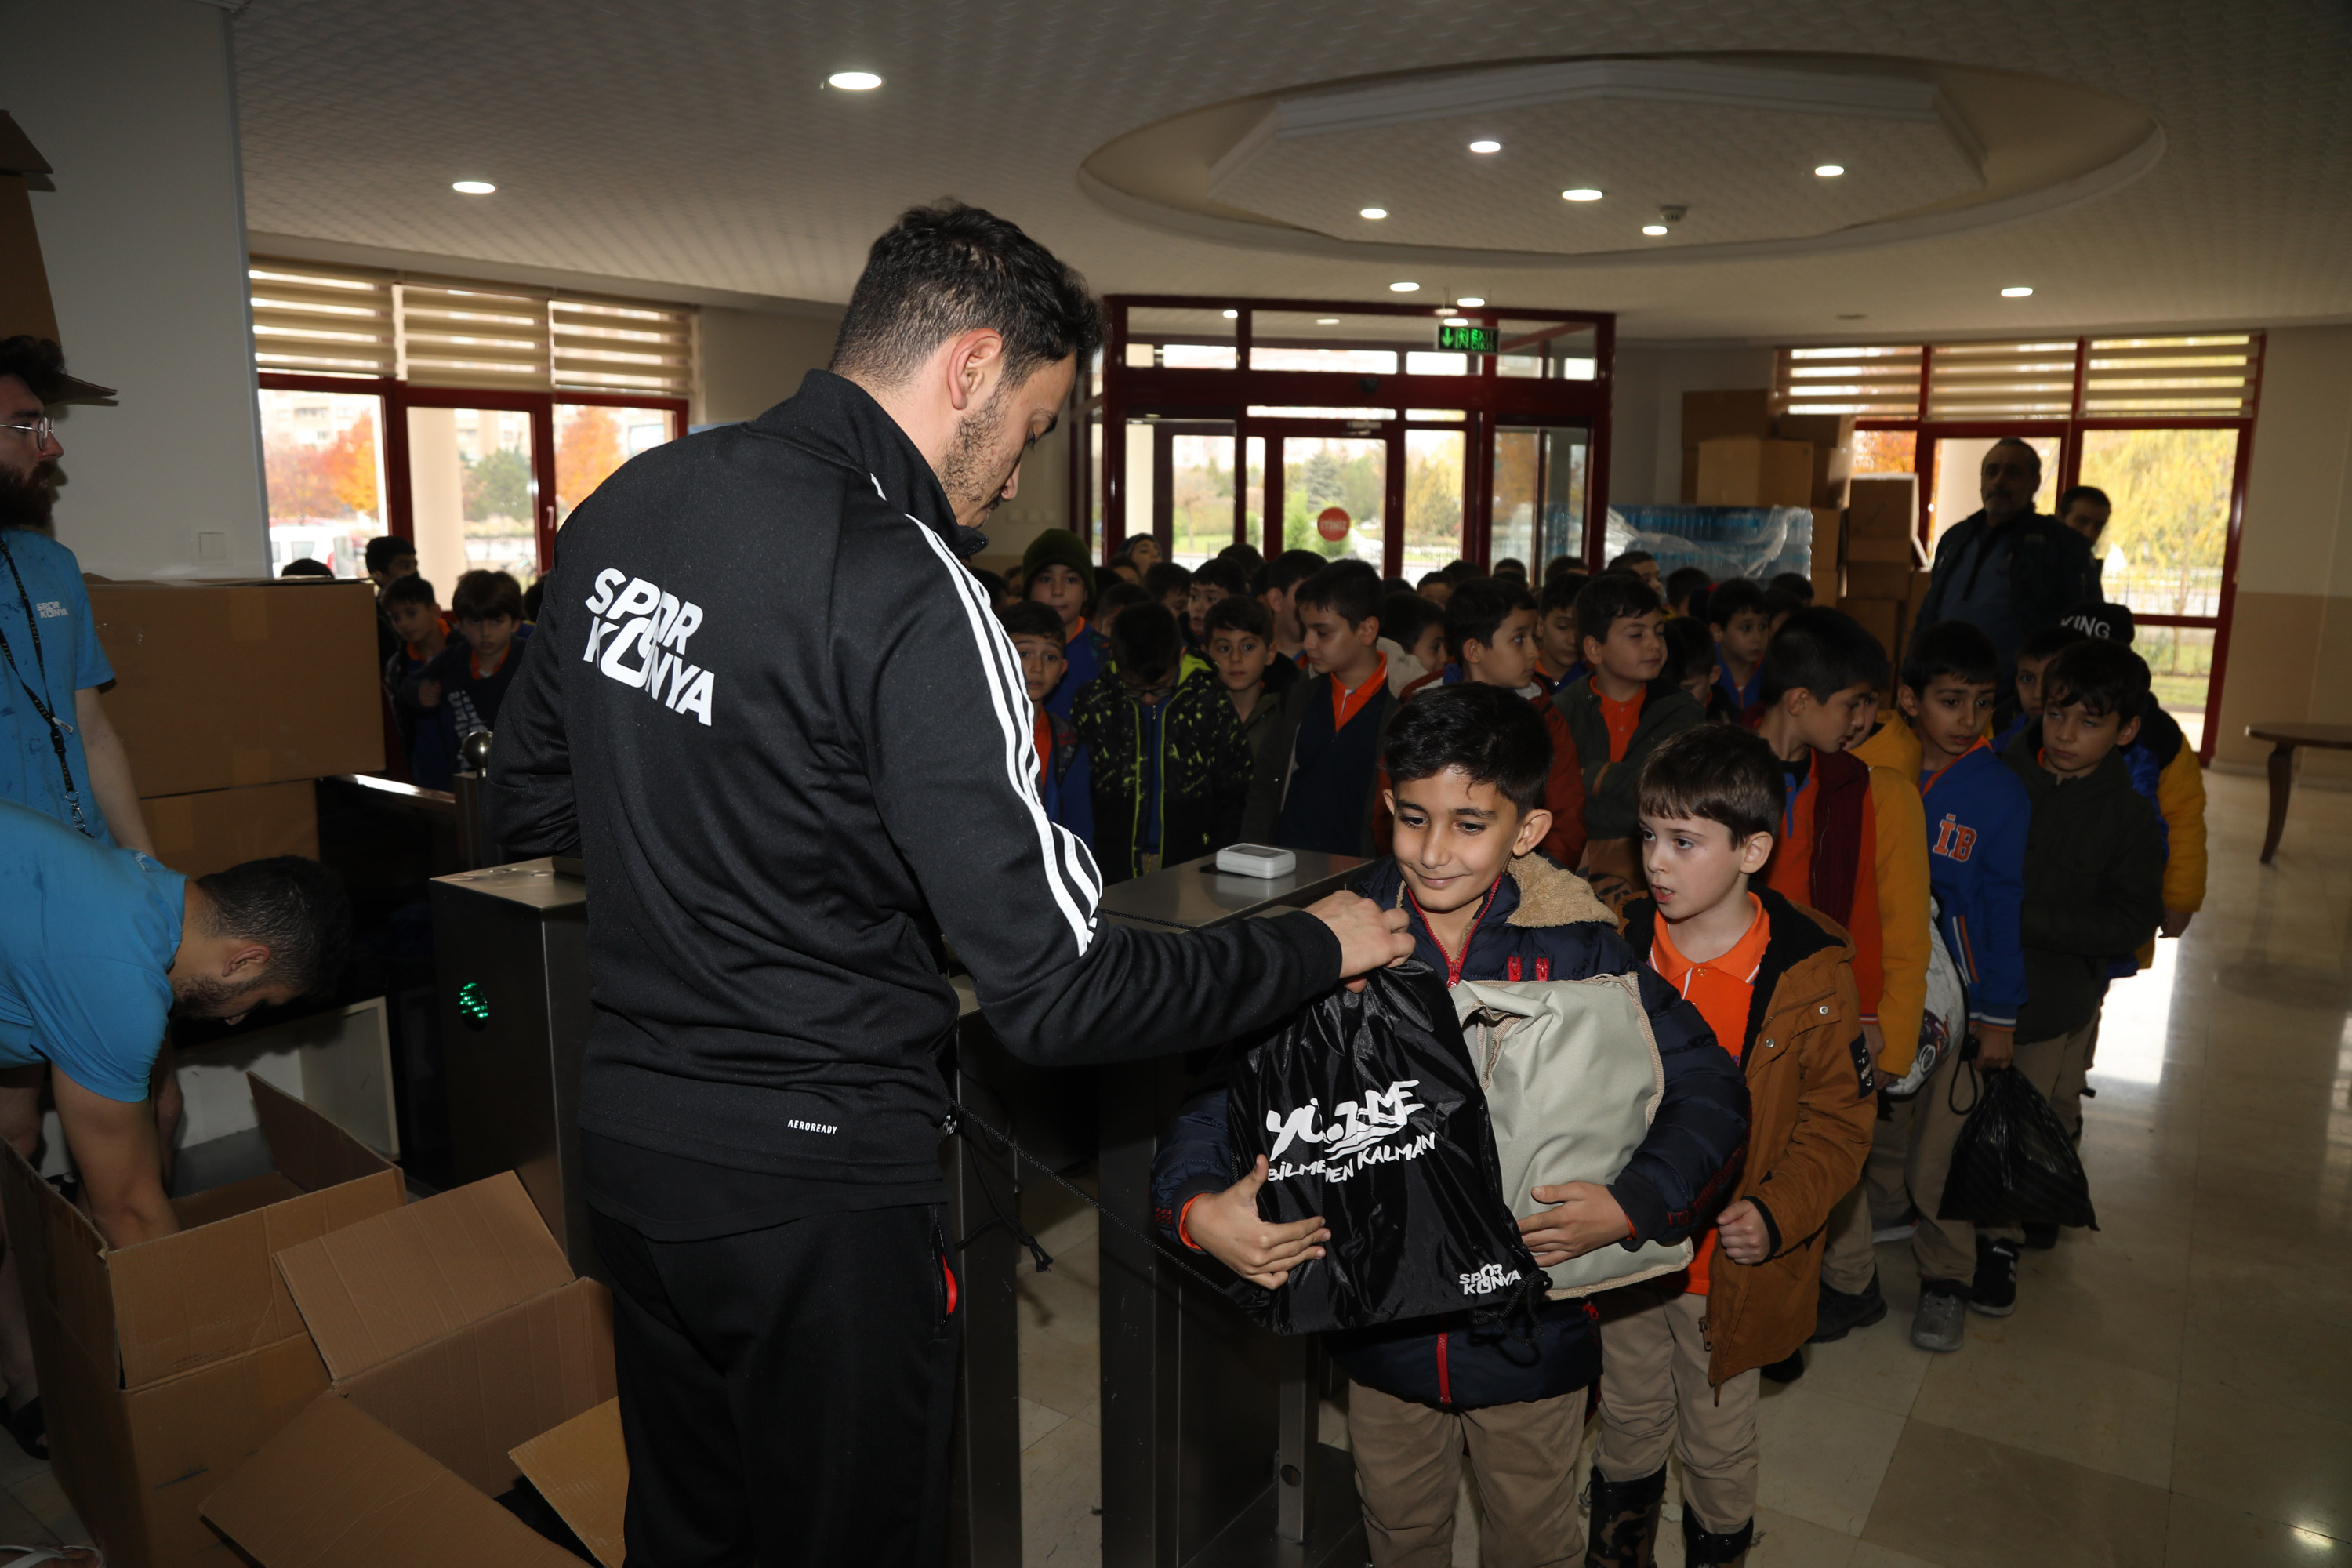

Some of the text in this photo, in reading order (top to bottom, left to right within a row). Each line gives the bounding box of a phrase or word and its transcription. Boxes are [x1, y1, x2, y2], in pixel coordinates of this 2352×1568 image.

[36, 601, 60, 612] SPOR
[40, 608, 69, 619] KONYA
[585, 568, 704, 657] SPOR
[583, 615, 715, 727] KONYA
[1933, 812, 1977, 862] İB
[787, 1119, 837, 1134] AEROREADY
[1459, 1263, 1503, 1286] SPOR
